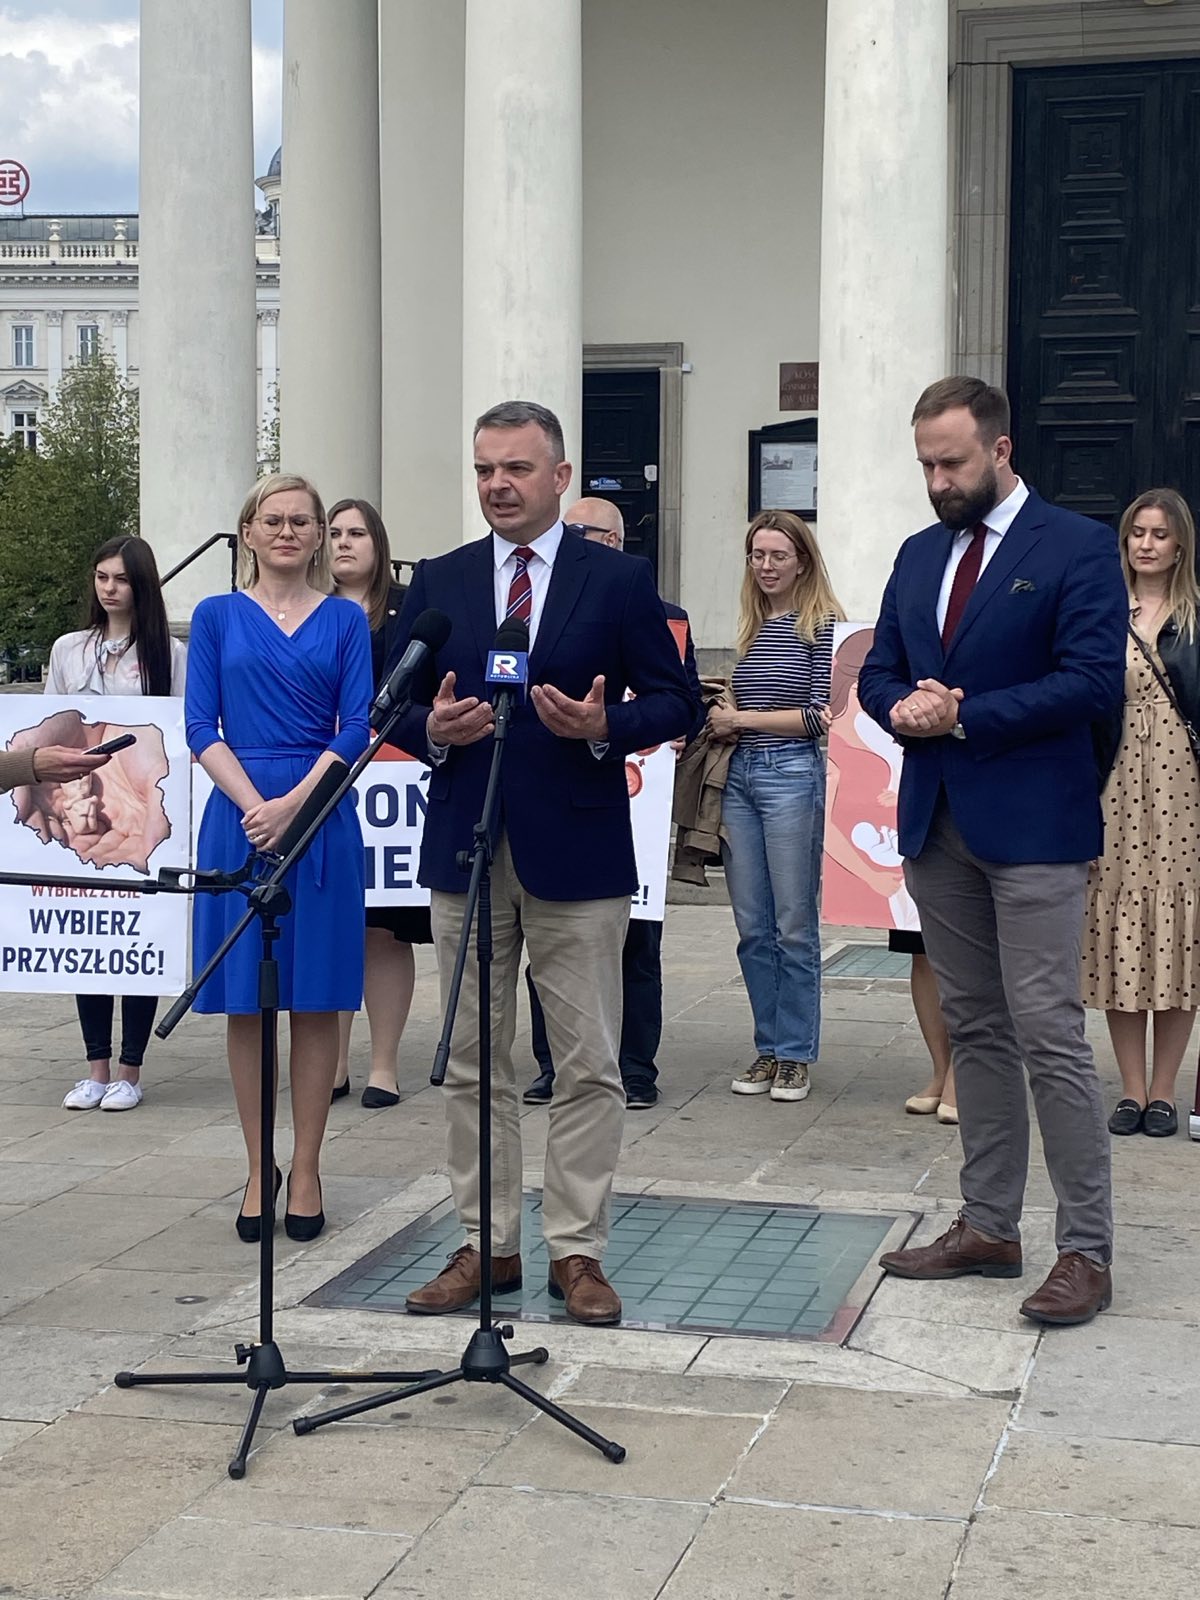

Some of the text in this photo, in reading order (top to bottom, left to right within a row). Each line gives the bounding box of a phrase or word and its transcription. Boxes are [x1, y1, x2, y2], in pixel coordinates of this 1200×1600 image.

[31, 884, 97, 898] WYBIERZ
[29, 908, 141, 936] WYBIERZ
[2, 942, 165, 975] PRZYSZŁOŚĆ!
